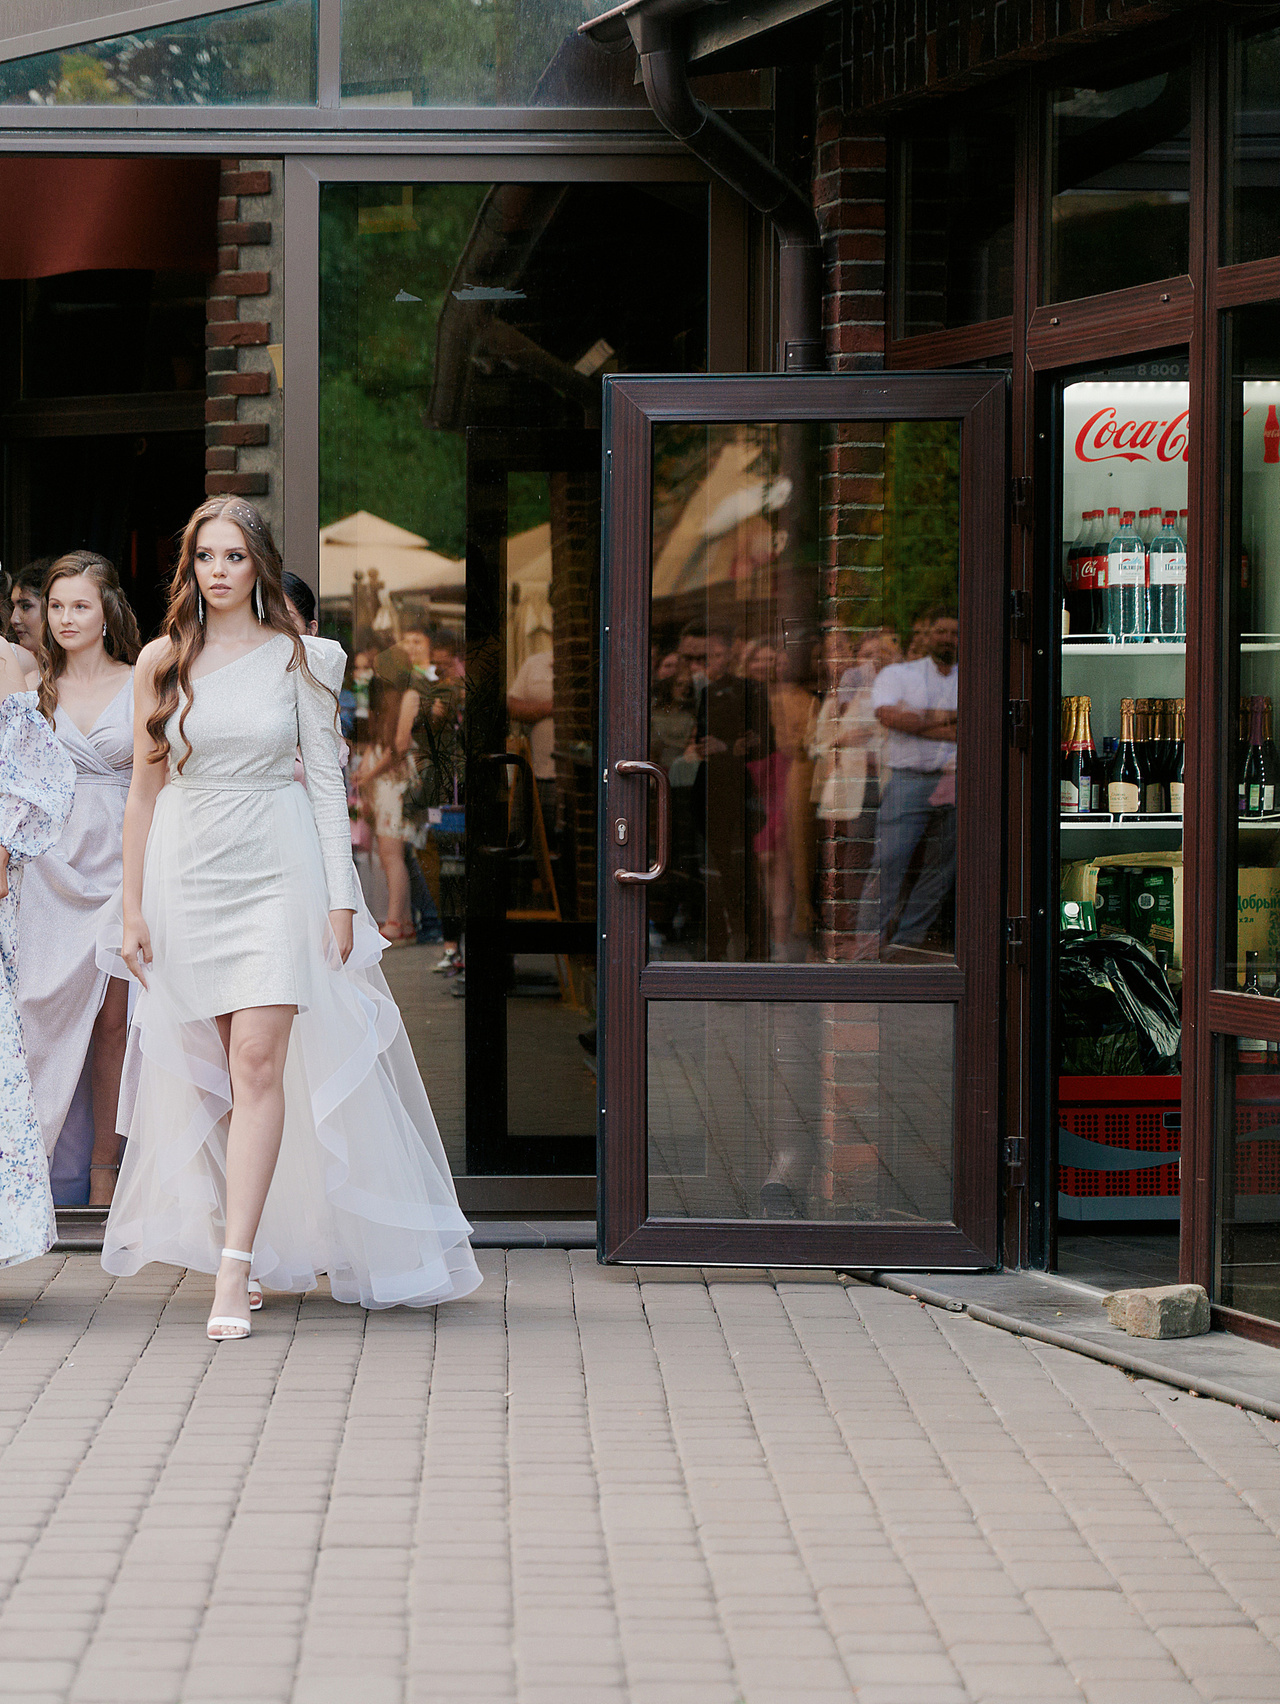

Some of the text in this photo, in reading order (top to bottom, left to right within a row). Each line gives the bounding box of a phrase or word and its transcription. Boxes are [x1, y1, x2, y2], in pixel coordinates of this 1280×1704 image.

[1137, 364, 1147, 376] 8
[1150, 364, 1180, 376] 800
[1074, 406, 1189, 463] Coca-C
